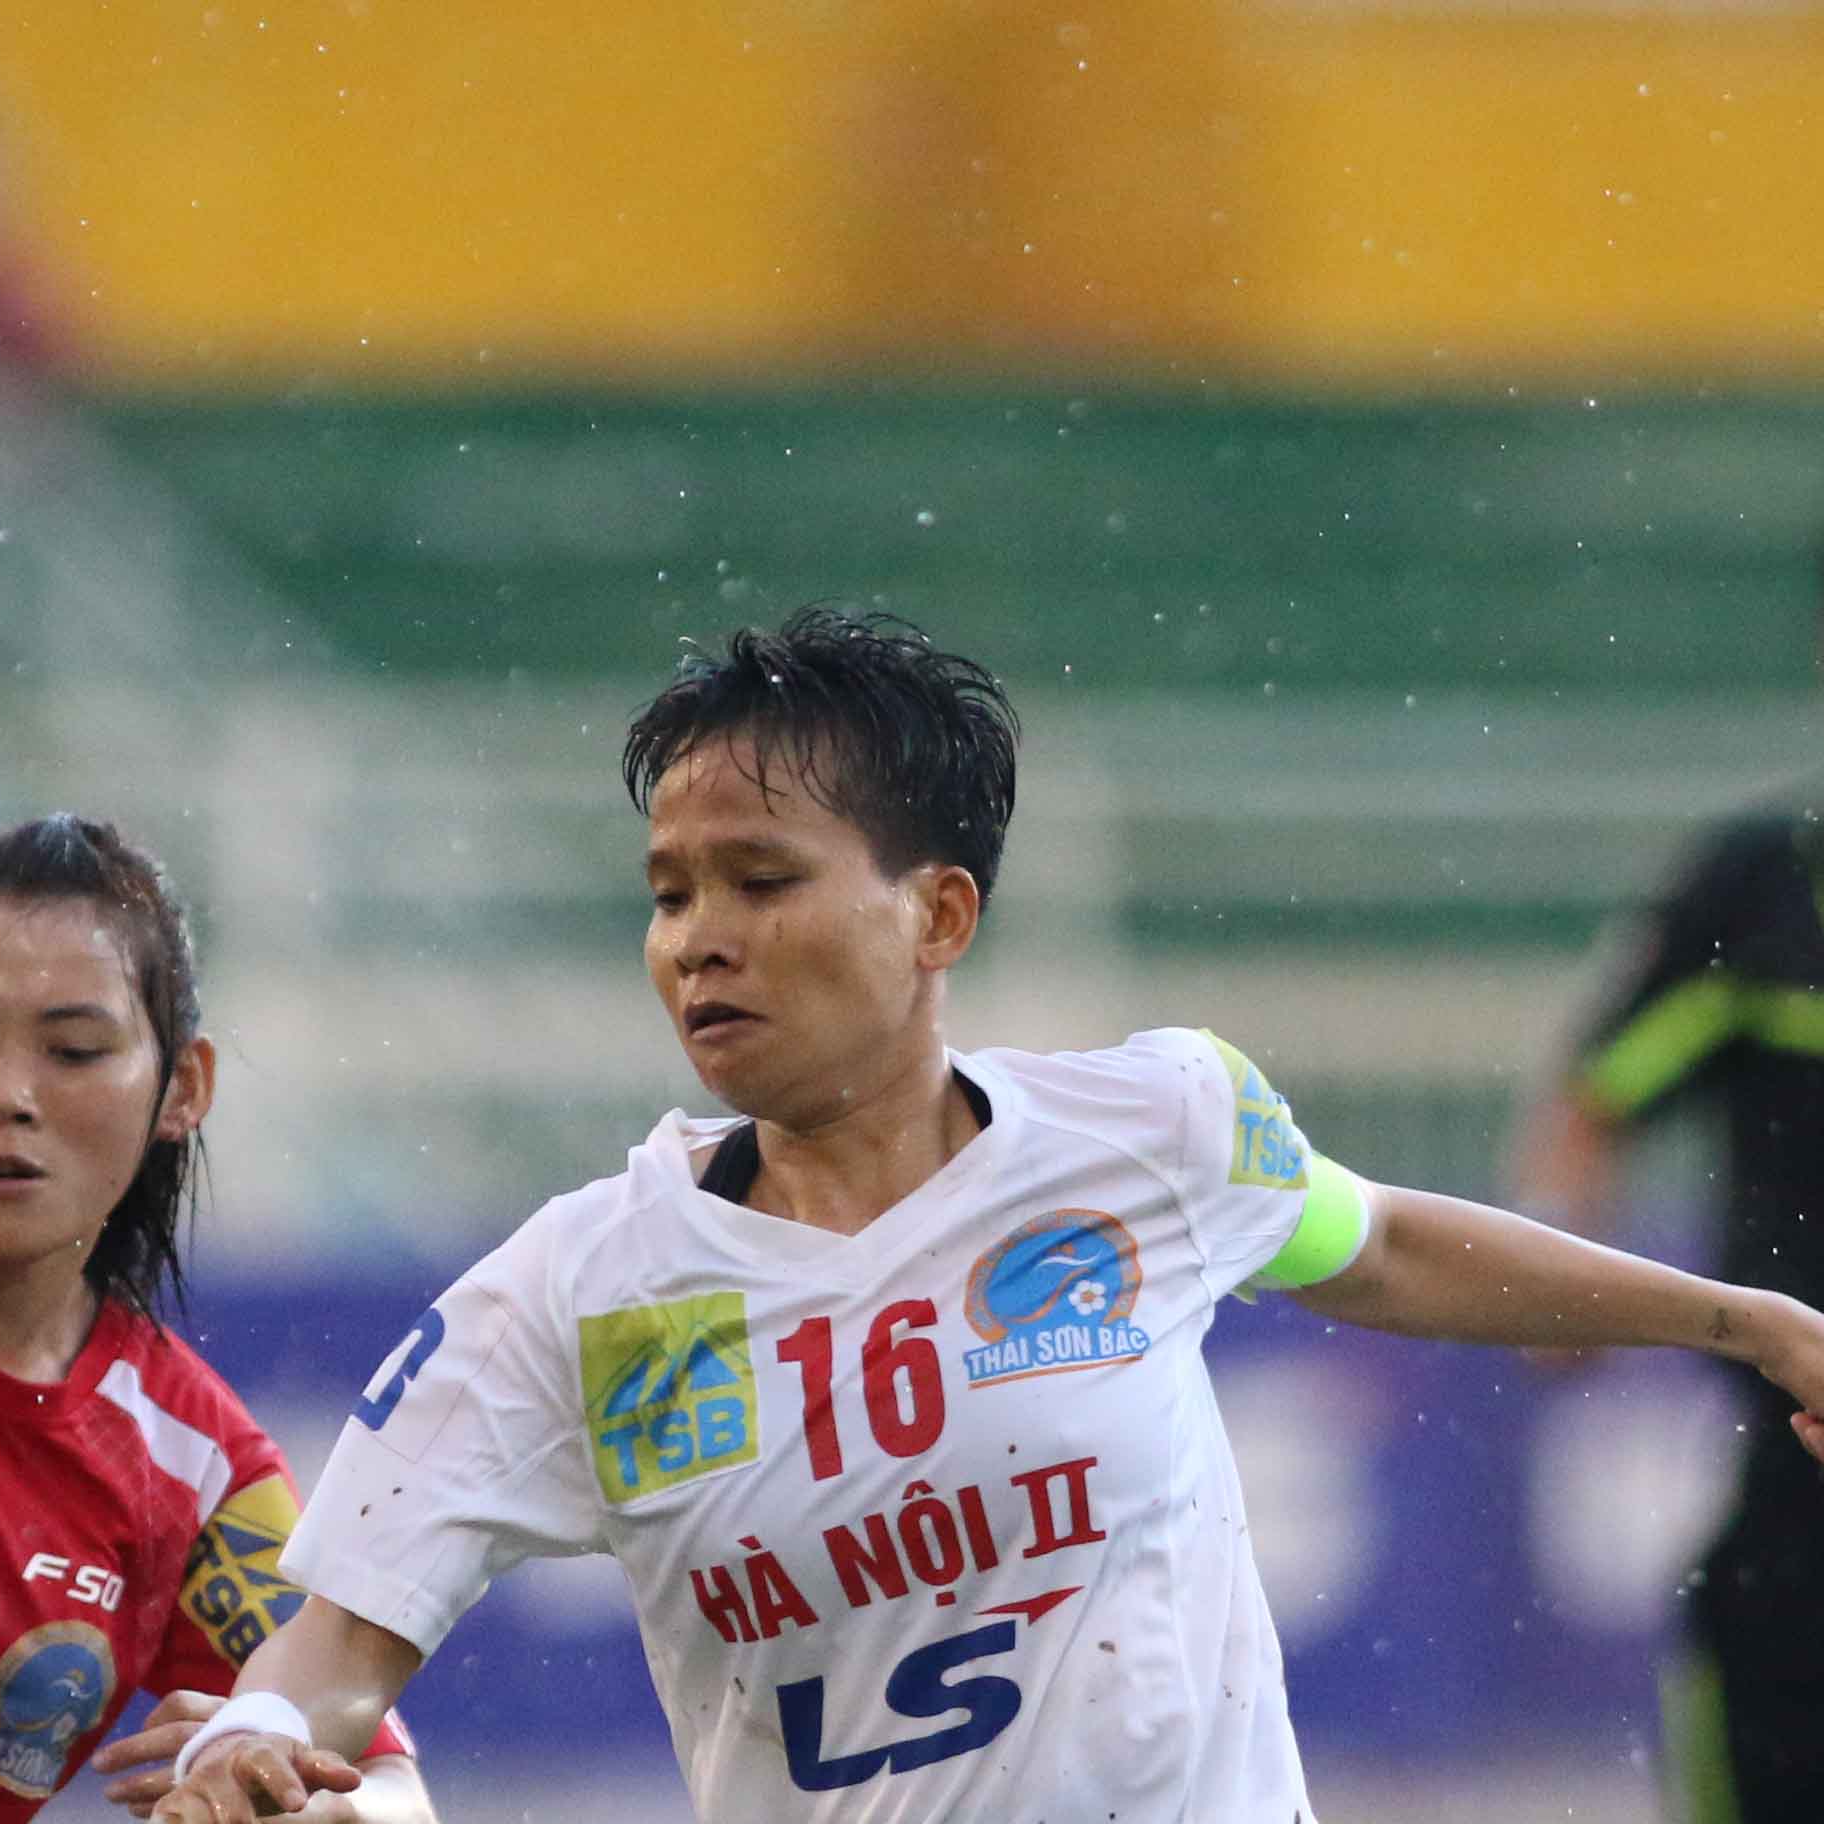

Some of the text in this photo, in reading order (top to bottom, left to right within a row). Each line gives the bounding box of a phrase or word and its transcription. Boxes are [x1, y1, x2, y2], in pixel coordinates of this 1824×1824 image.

[1238, 1111, 1304, 1181] TSB
[599, 1396, 748, 1489] TSB
[776, 1297, 945, 1482] 16
[689, 1456, 1107, 1643] HÀ NỘI II
[776, 1619, 1022, 1792] LS
